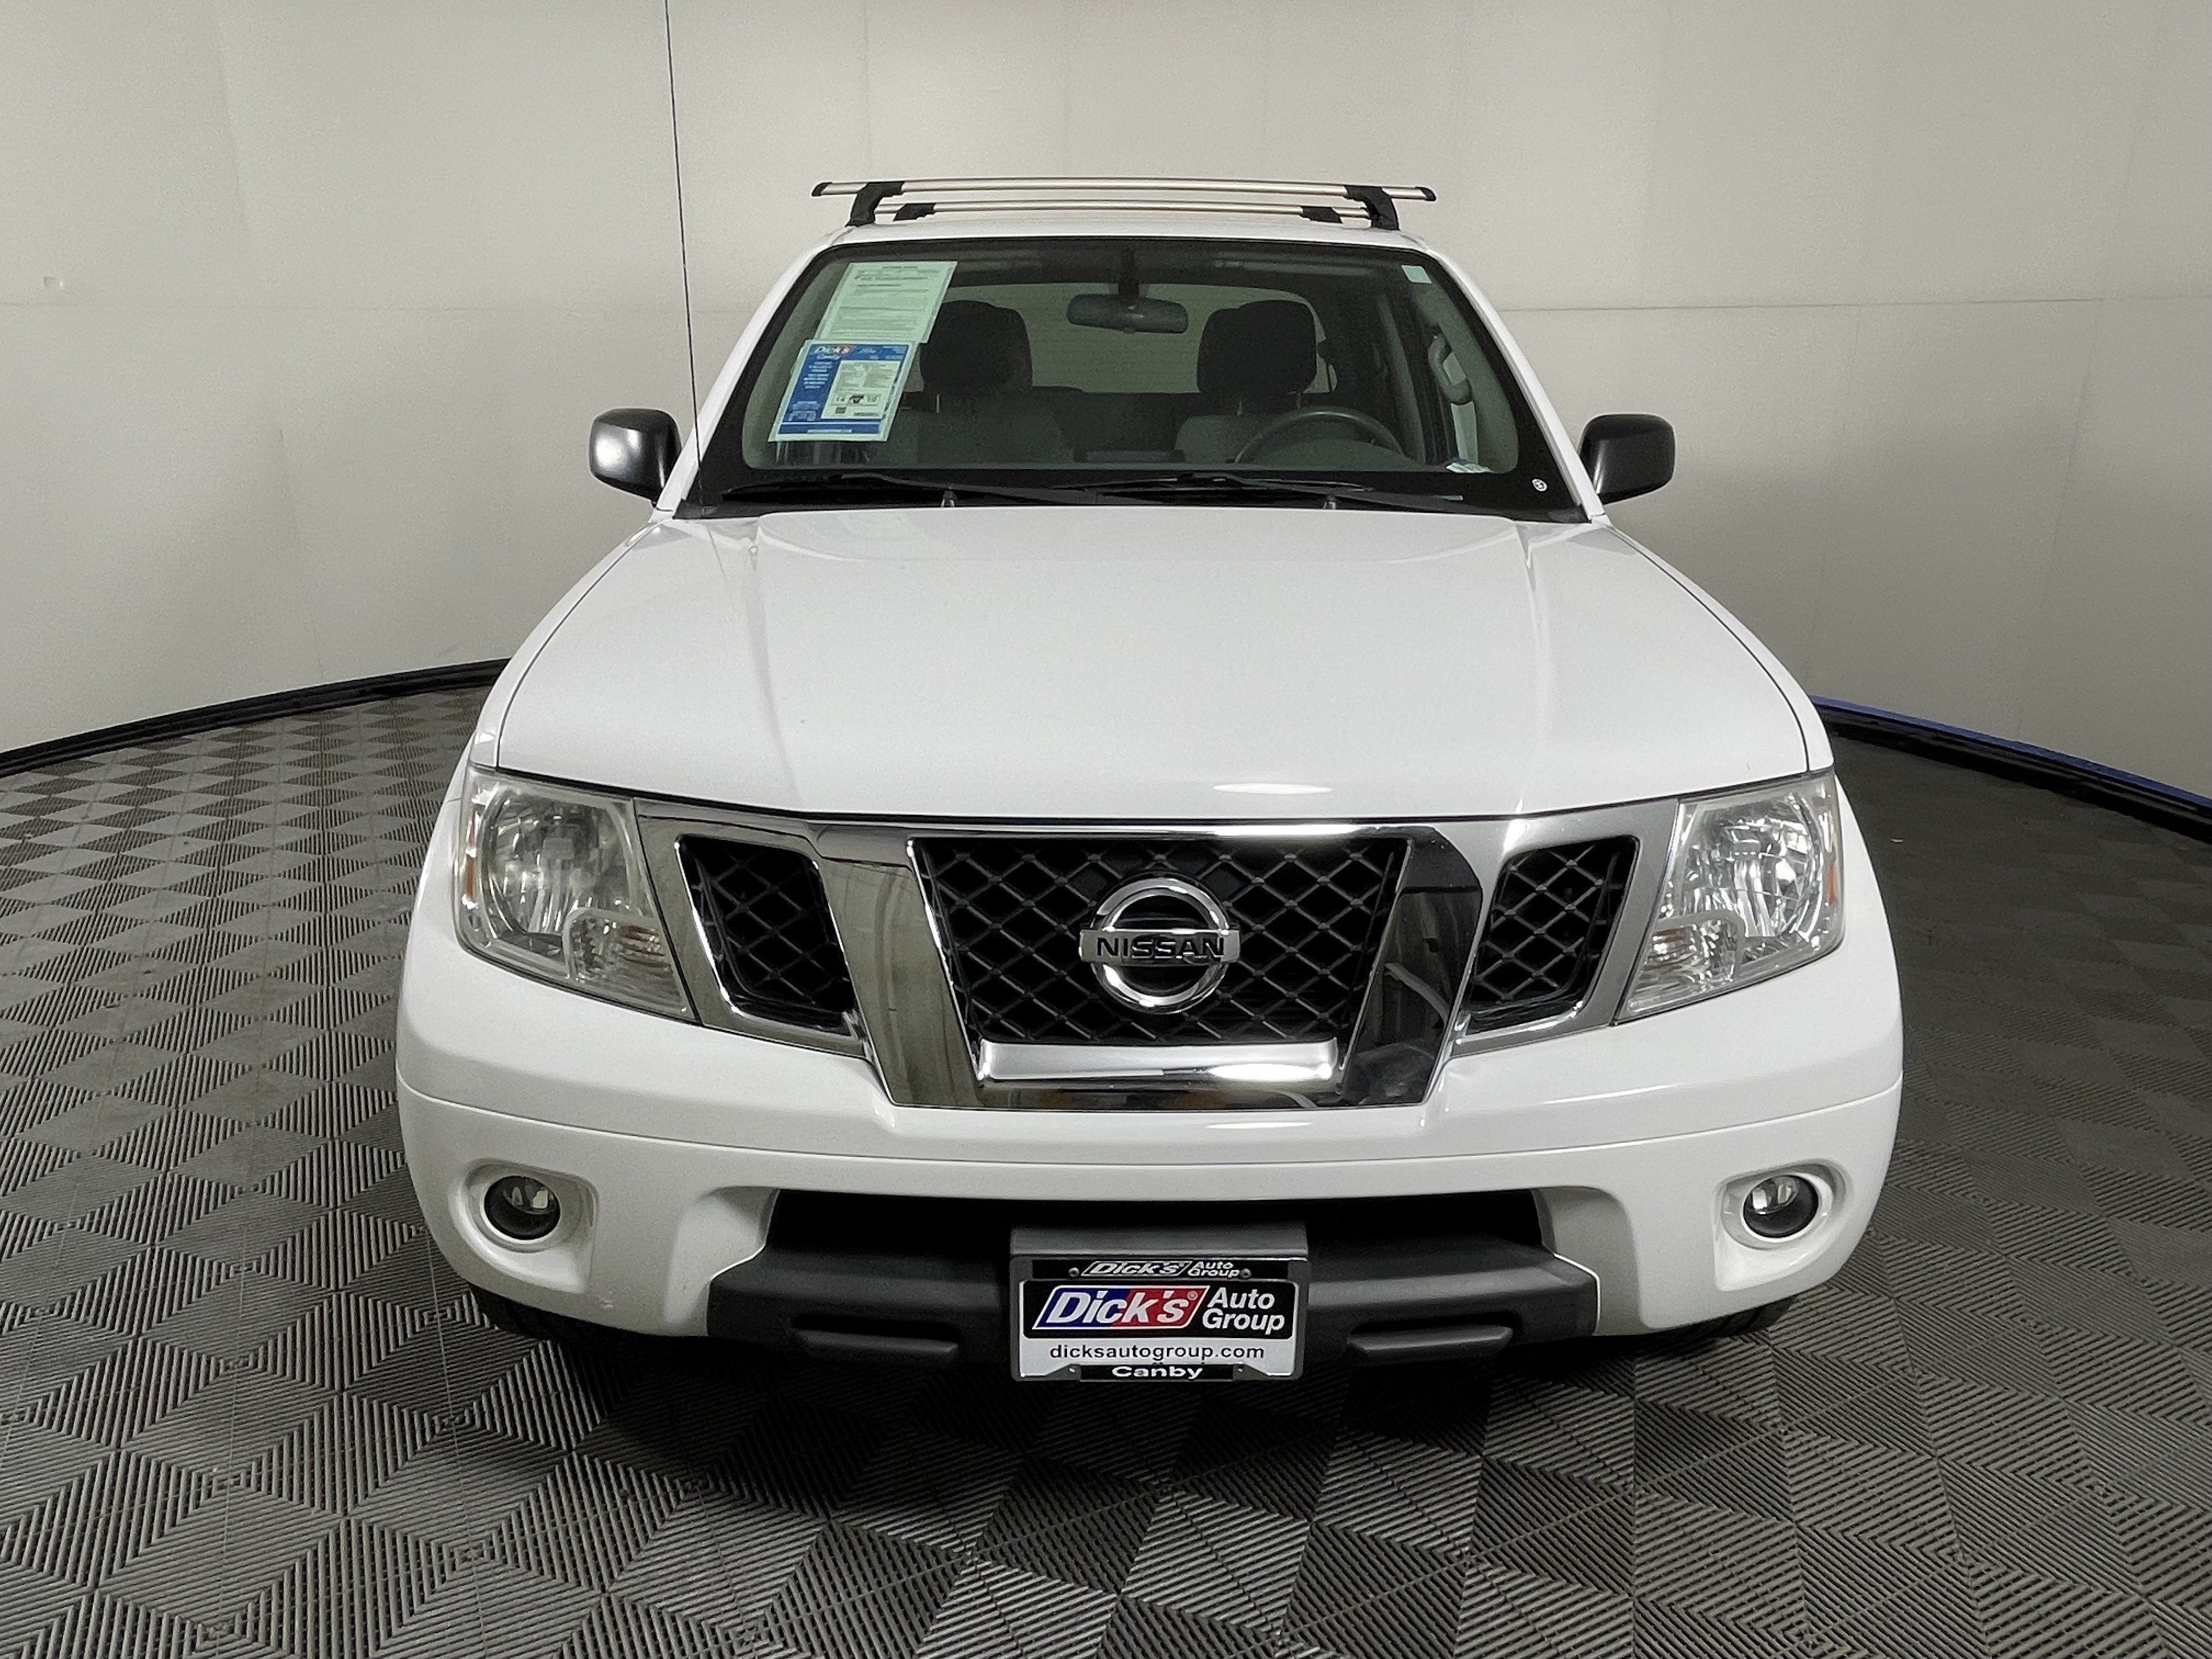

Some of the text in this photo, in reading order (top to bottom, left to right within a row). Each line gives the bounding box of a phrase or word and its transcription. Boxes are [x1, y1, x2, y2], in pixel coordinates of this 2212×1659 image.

[1097, 937, 1225, 960] NISSAN
[1090, 1261, 1180, 1274] Dick's
[1190, 1261, 1233, 1269] Auto
[1187, 1269, 1240, 1278] Group
[1207, 1287, 1275, 1309] Auto
[1046, 1290, 1189, 1323] Dick's
[1203, 1308, 1285, 1335] Group
[1049, 1345, 1264, 1361] dicksautogroup.com
[1111, 1366, 1203, 1379] Canby
